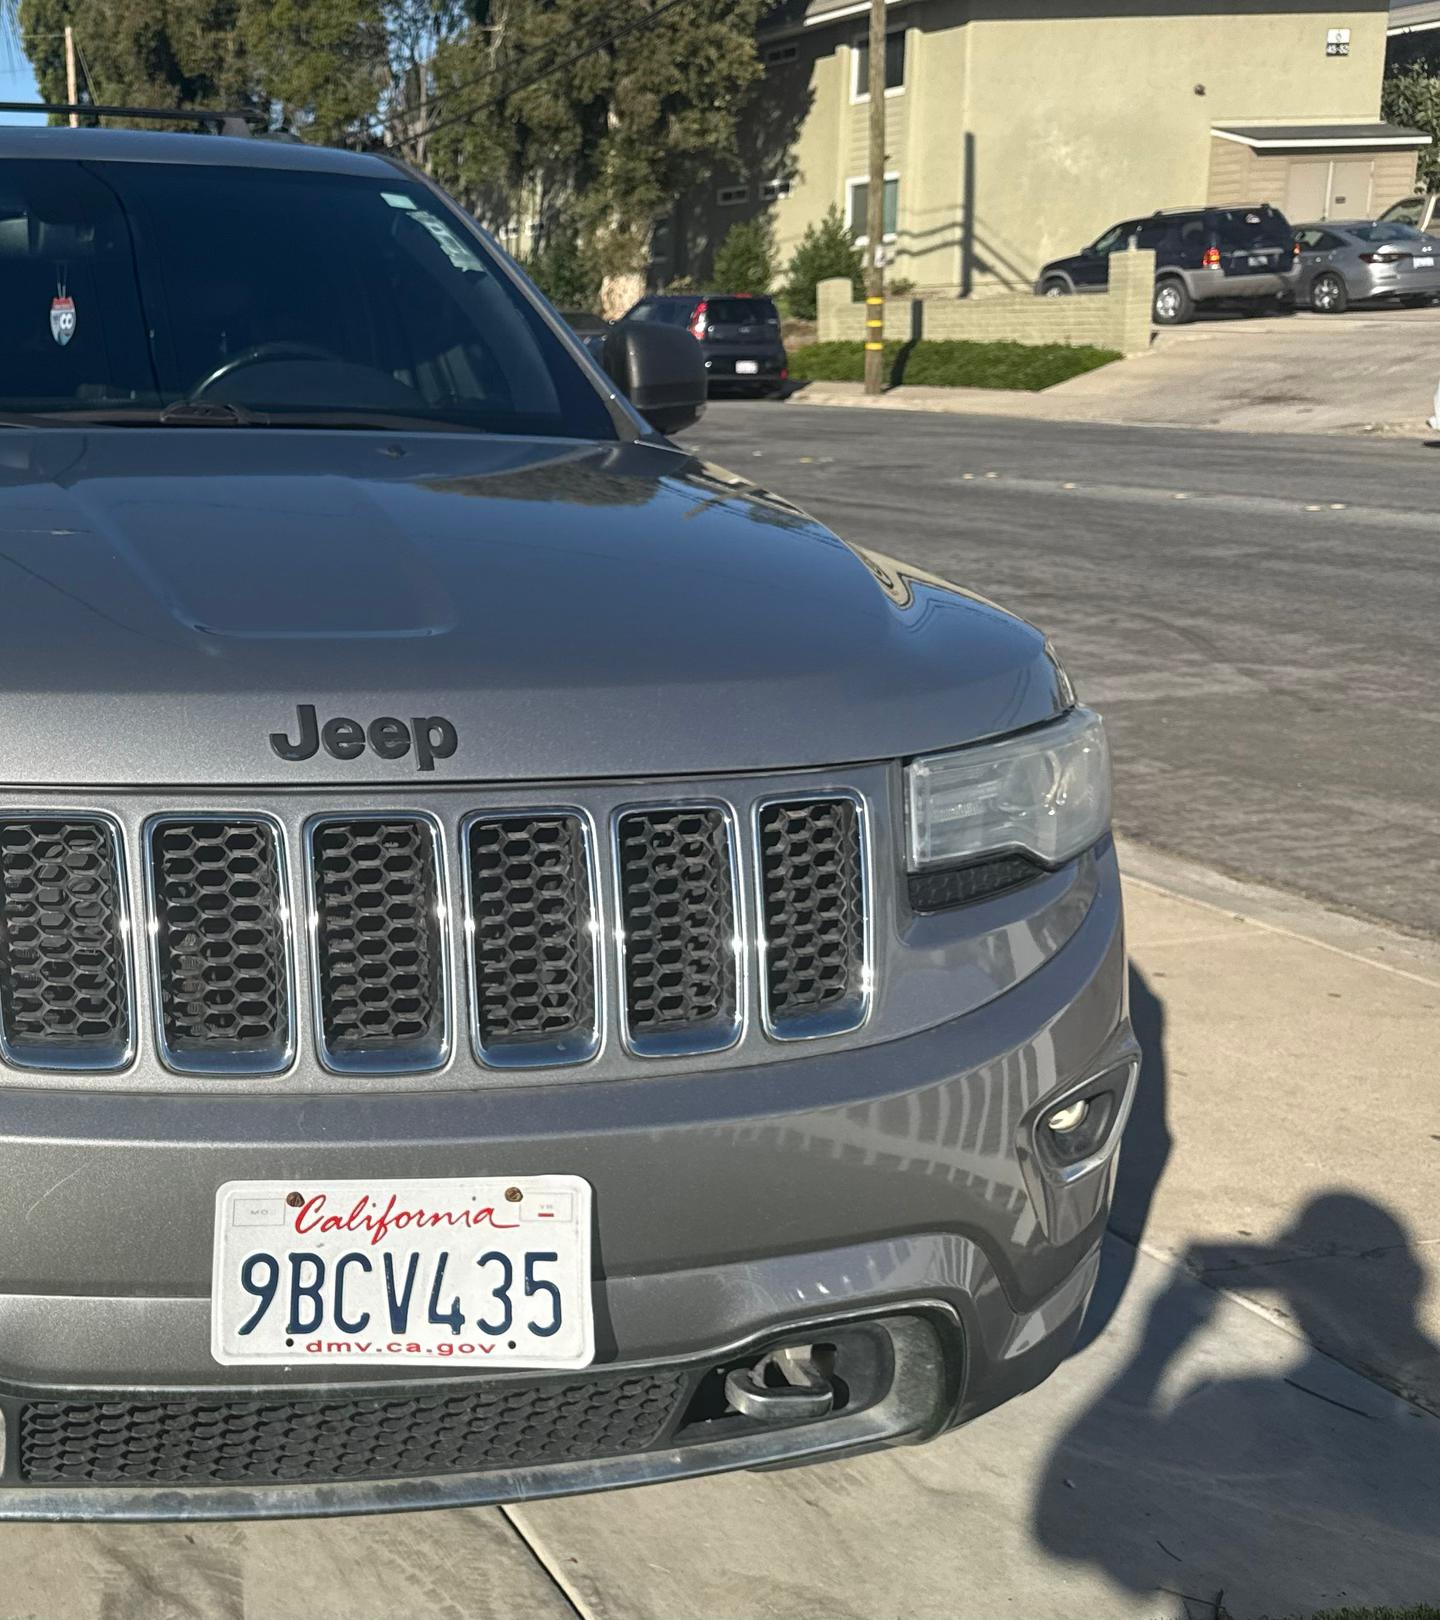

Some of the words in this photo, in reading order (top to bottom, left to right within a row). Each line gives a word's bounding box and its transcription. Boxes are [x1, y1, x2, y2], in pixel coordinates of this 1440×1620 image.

[269, 704, 458, 772] Jeep
[294, 1194, 520, 1245] California
[238, 1250, 563, 1337] 9BCV435
[305, 1339, 497, 1357] dmv.ca.gov
